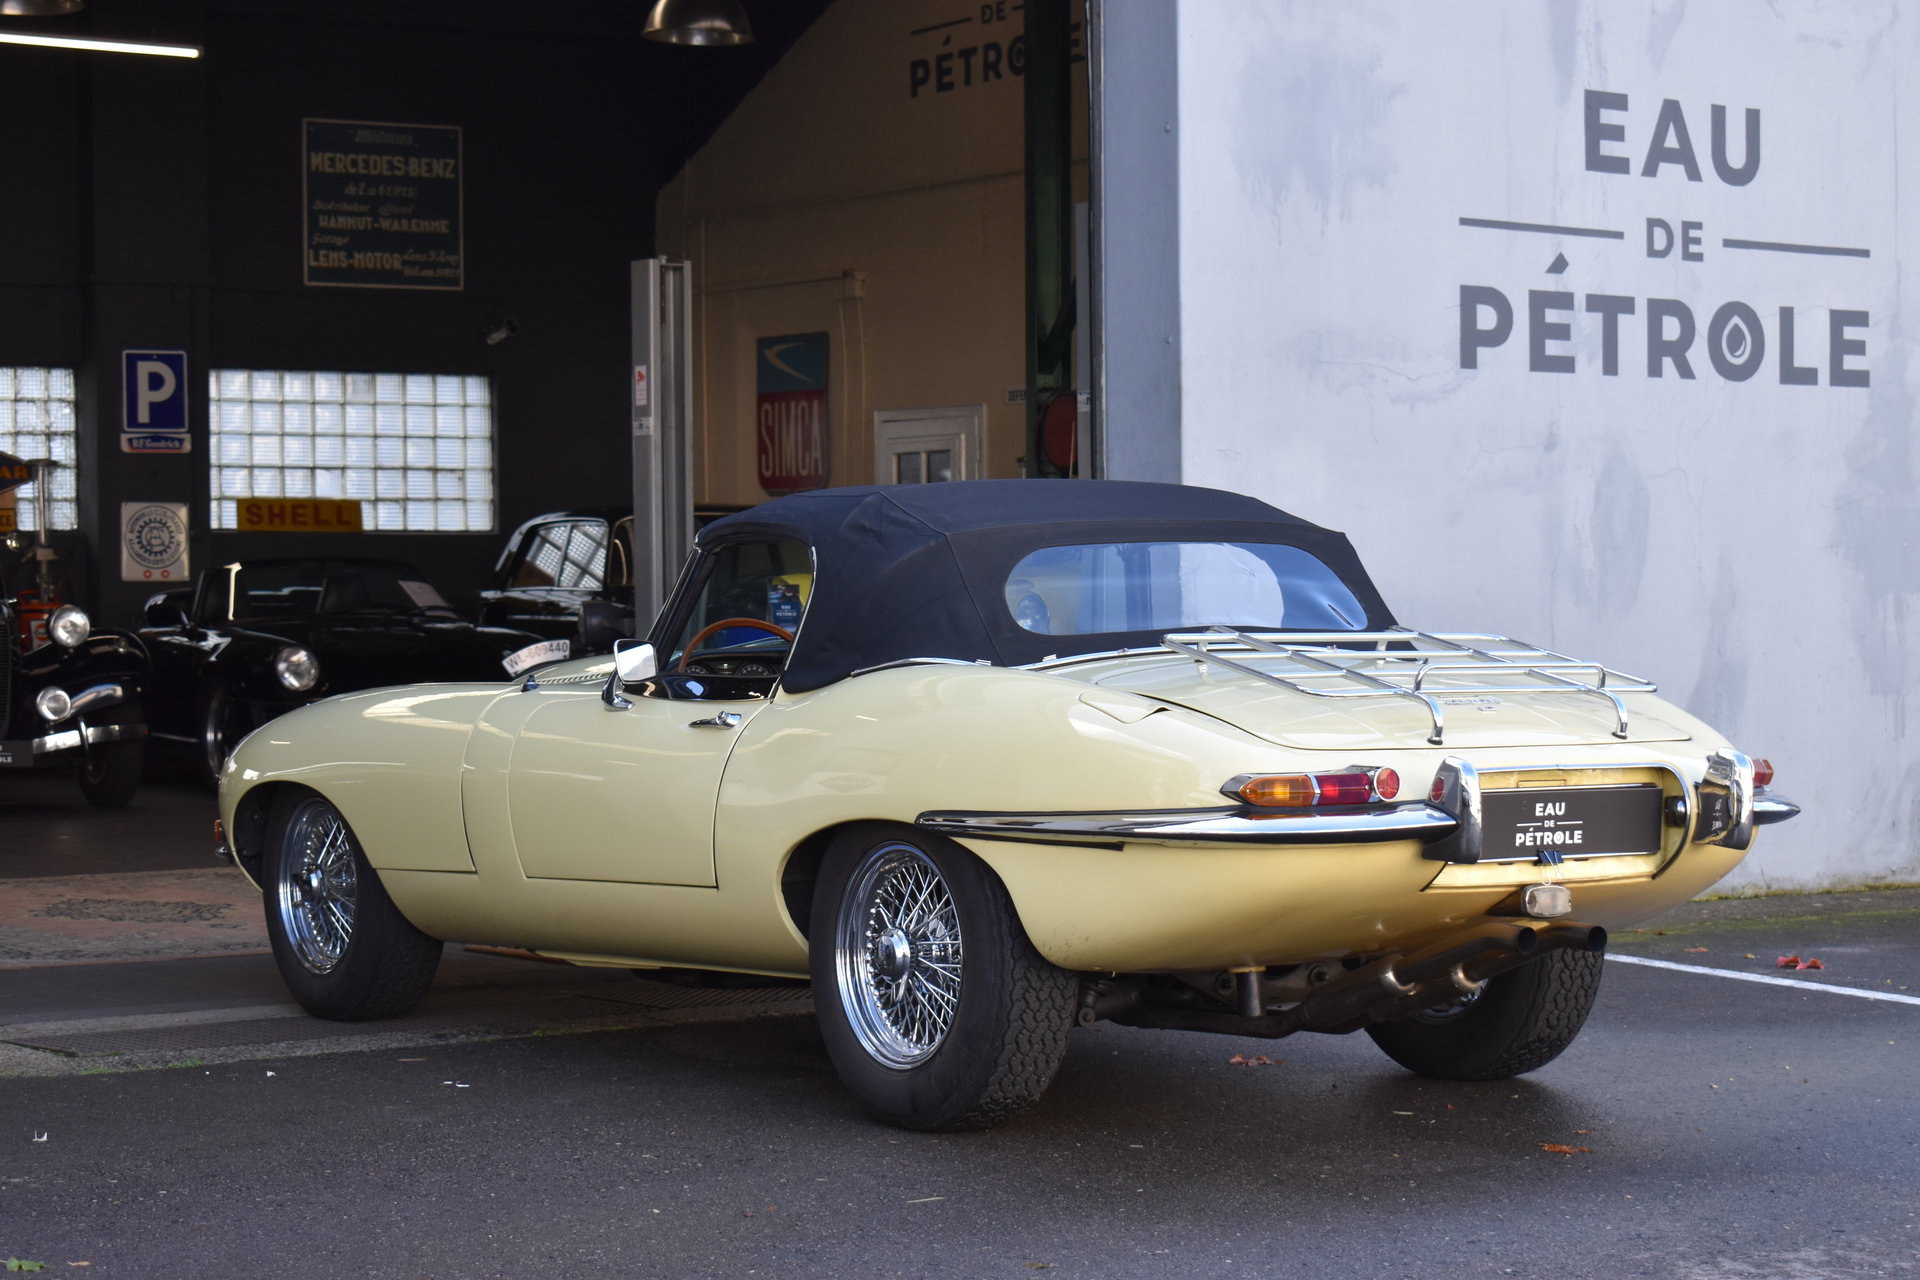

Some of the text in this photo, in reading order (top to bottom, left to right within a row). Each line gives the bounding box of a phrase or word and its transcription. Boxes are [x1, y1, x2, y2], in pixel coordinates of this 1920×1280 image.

[981, 2, 1006, 24] DE
[910, 23, 1087, 98] PÉTROE
[1584, 89, 1762, 187] EAU
[310, 151, 456, 179] MERCEDES-BENZ
[1646, 217, 1704, 263] DE
[1459, 252, 1871, 388] PÉTROLE
[137, 361, 176, 424] P
[1008, 390, 1026, 402] DEFE
[761, 399, 823, 478] SIMCA
[245, 503, 353, 526] SHELL
[506, 641, 569, 669] WL-609440
[1535, 802, 1566, 817] EAU
[1515, 827, 1583, 847] PÉTROLE
[1544, 820, 1555, 828] DE
